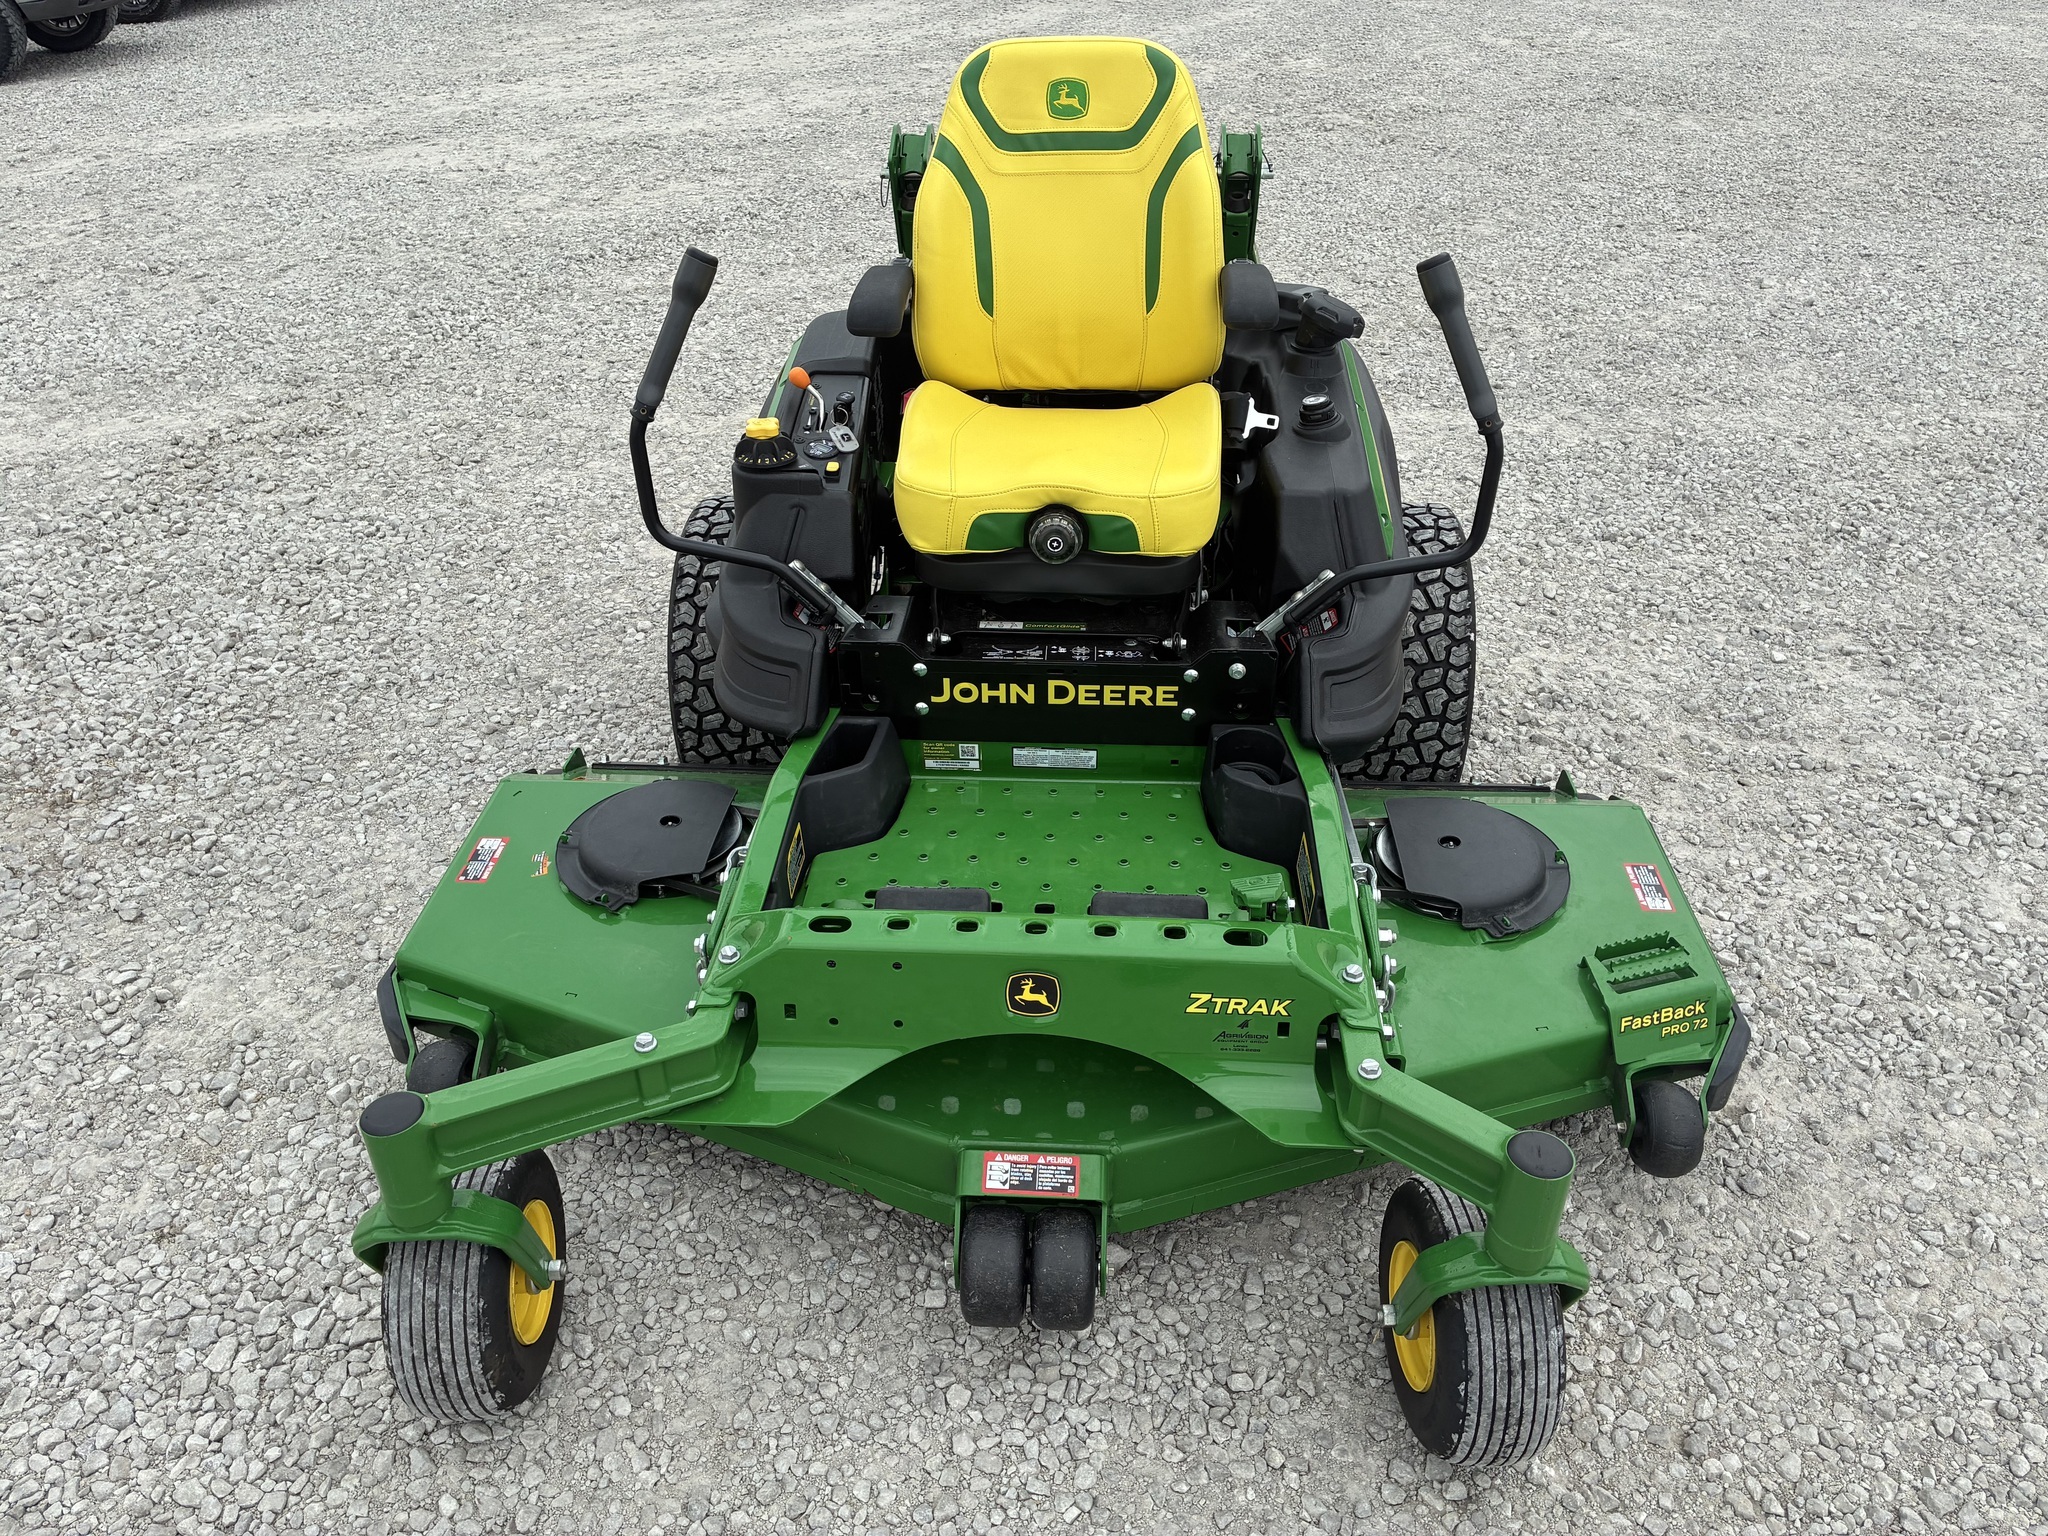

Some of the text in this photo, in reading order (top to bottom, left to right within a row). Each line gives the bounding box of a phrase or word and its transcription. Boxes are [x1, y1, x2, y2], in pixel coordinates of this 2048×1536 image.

[931, 678, 1178, 706] JOHN DEERE
[1185, 993, 1293, 1016] ZTRAK
[1620, 1000, 1705, 1032] FastBack
[1662, 1018, 1708, 1037] PRO 72
